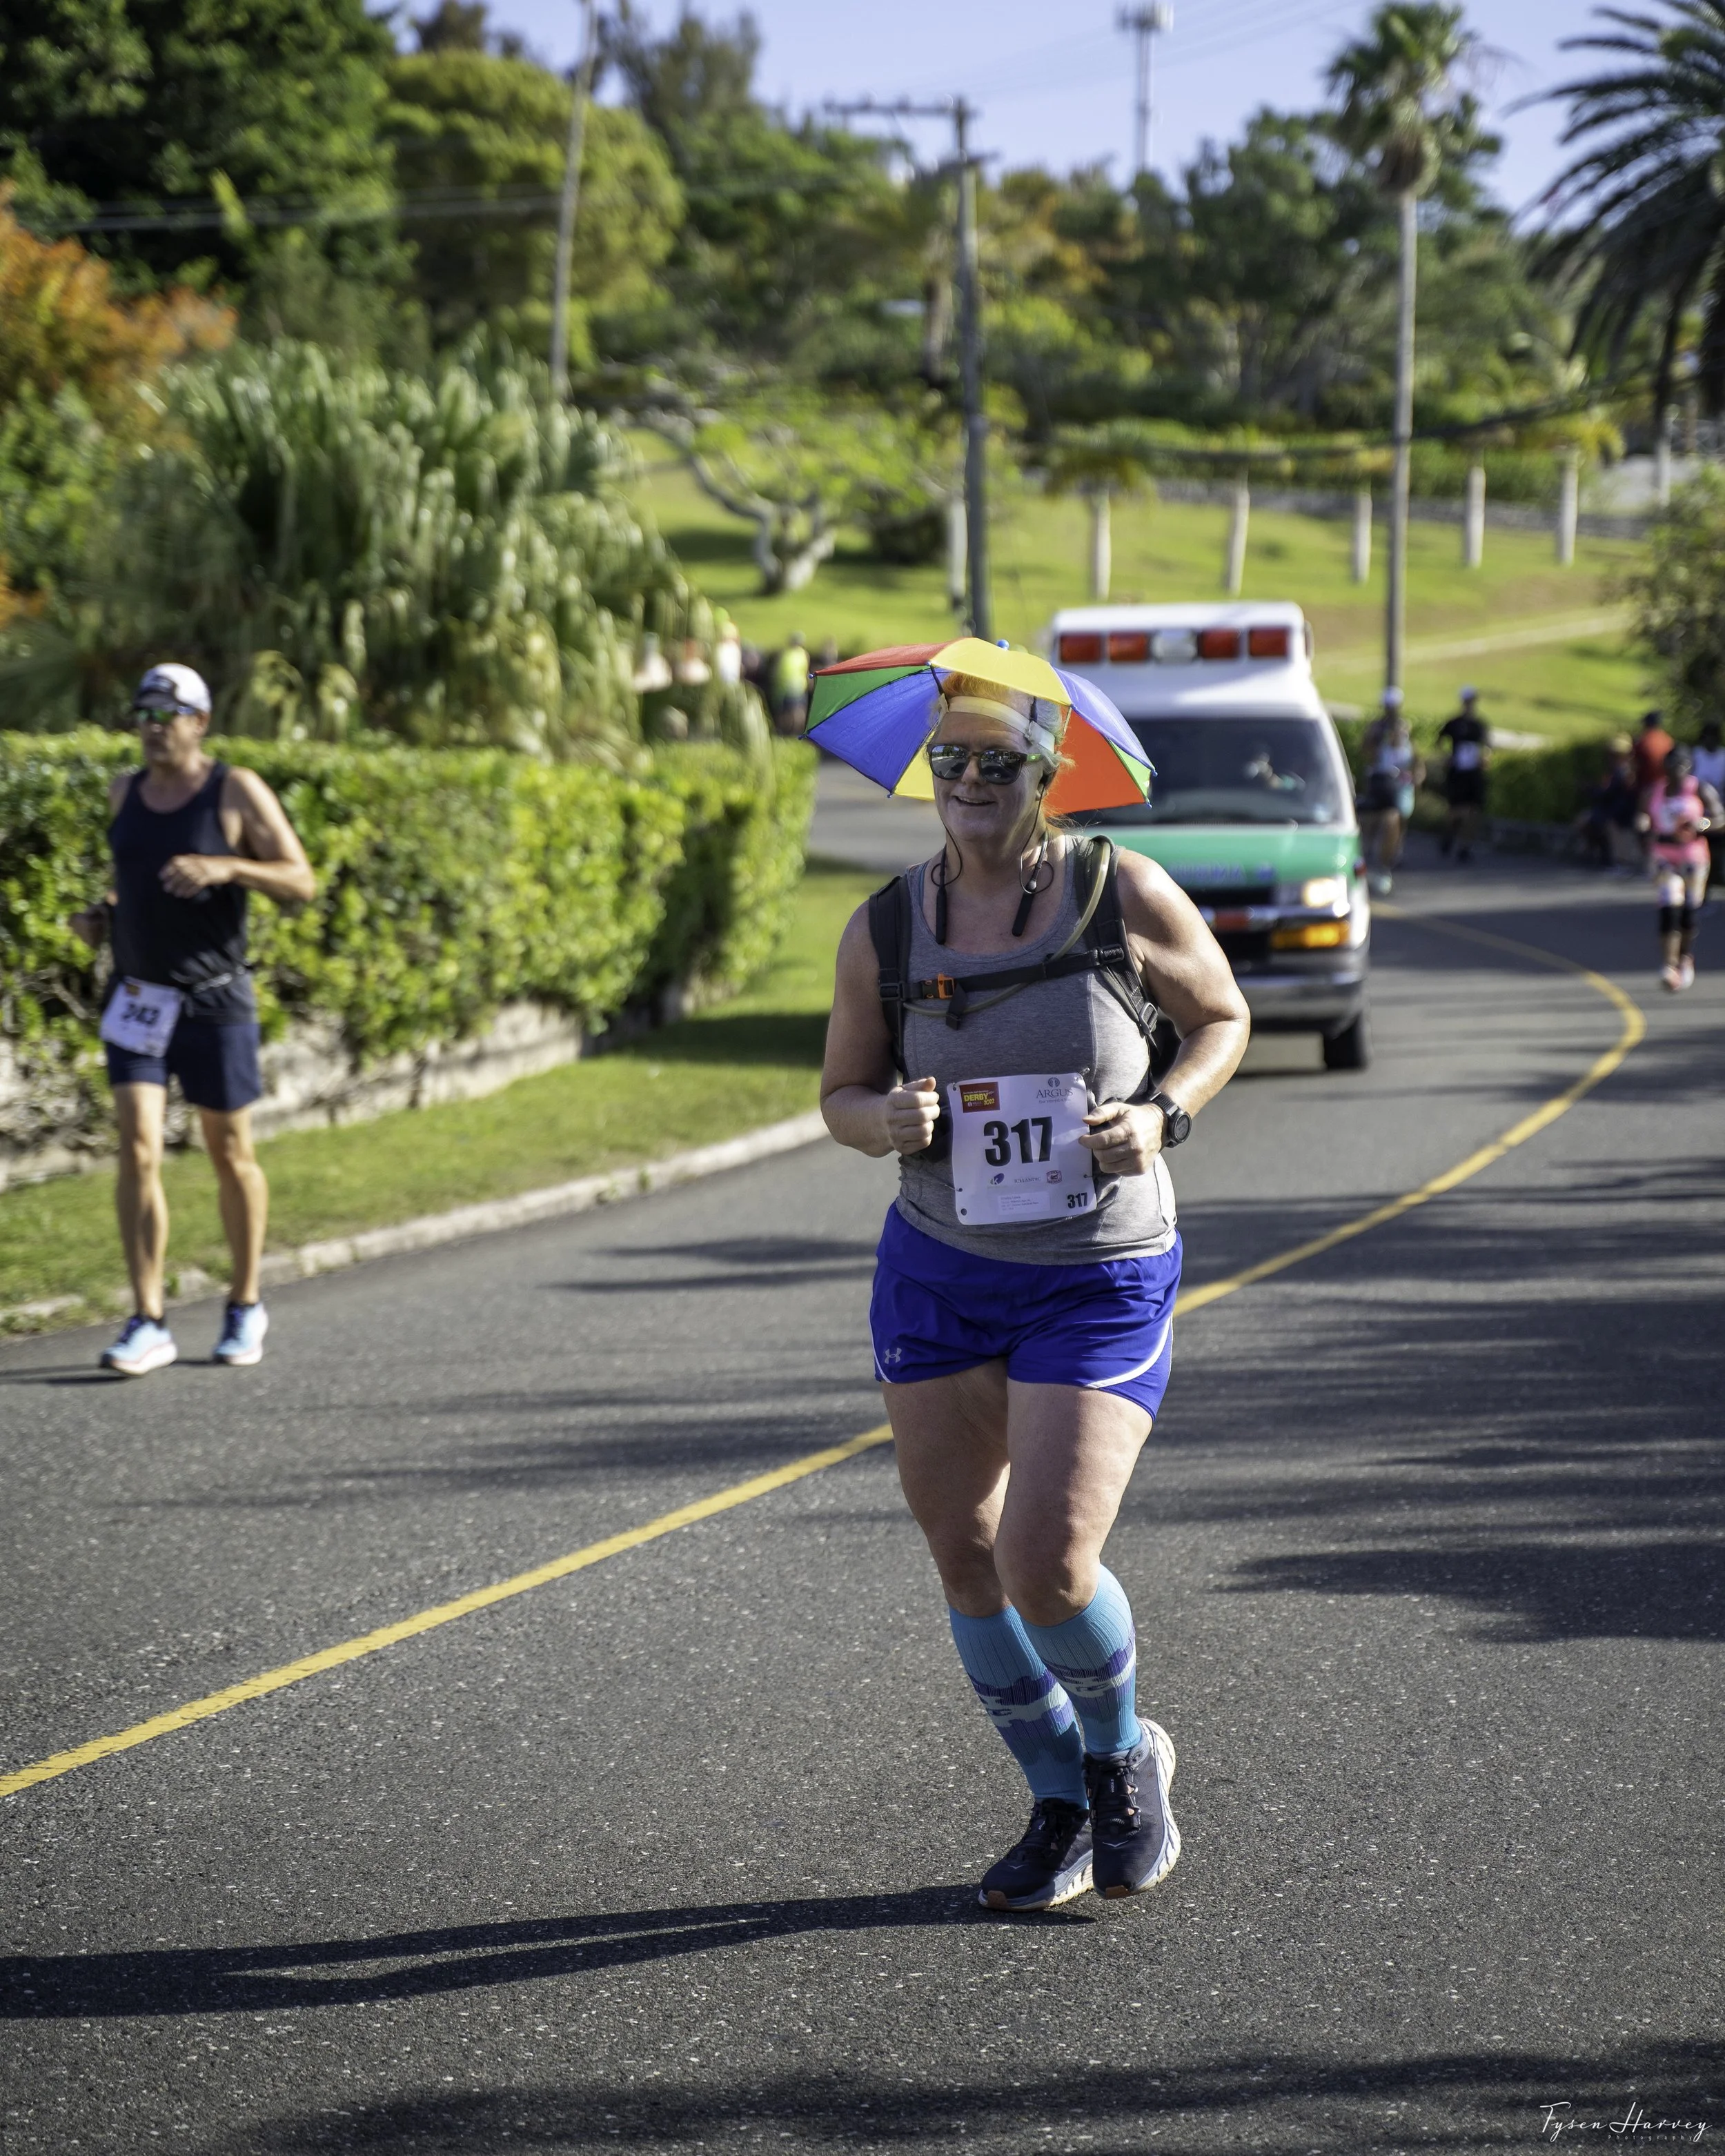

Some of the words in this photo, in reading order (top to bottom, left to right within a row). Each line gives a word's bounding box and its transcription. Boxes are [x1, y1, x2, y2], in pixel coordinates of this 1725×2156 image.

[964, 1093, 988, 1102] DERBY
[1036, 1089, 1074, 1098] ARGUS
[983, 1116, 1053, 1167] 317
[1067, 1192, 1088, 1208] 317
